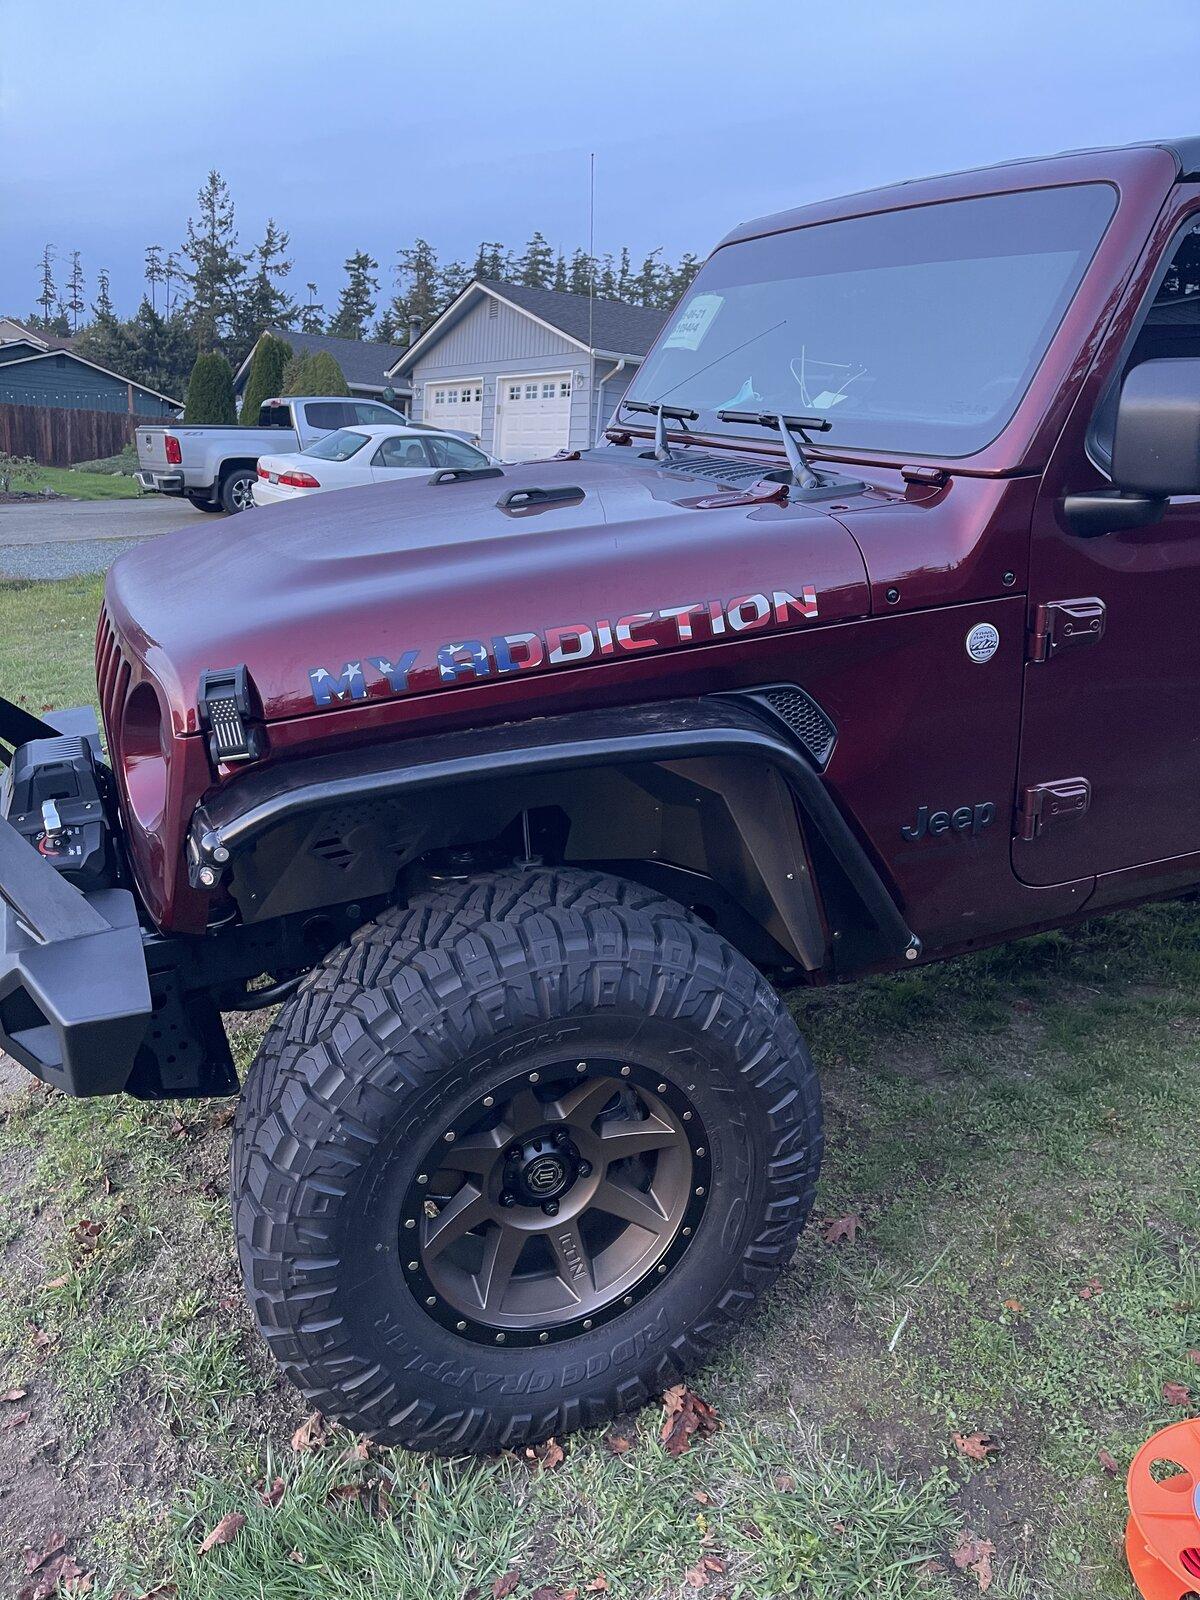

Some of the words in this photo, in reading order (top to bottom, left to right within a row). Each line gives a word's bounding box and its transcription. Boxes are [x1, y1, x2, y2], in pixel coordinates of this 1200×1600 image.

[308, 648, 421, 706] MY
[437, 585, 819, 682] ADDICTION
[900, 801, 996, 841] Jeep
[558, 1232, 588, 1281] ICON
